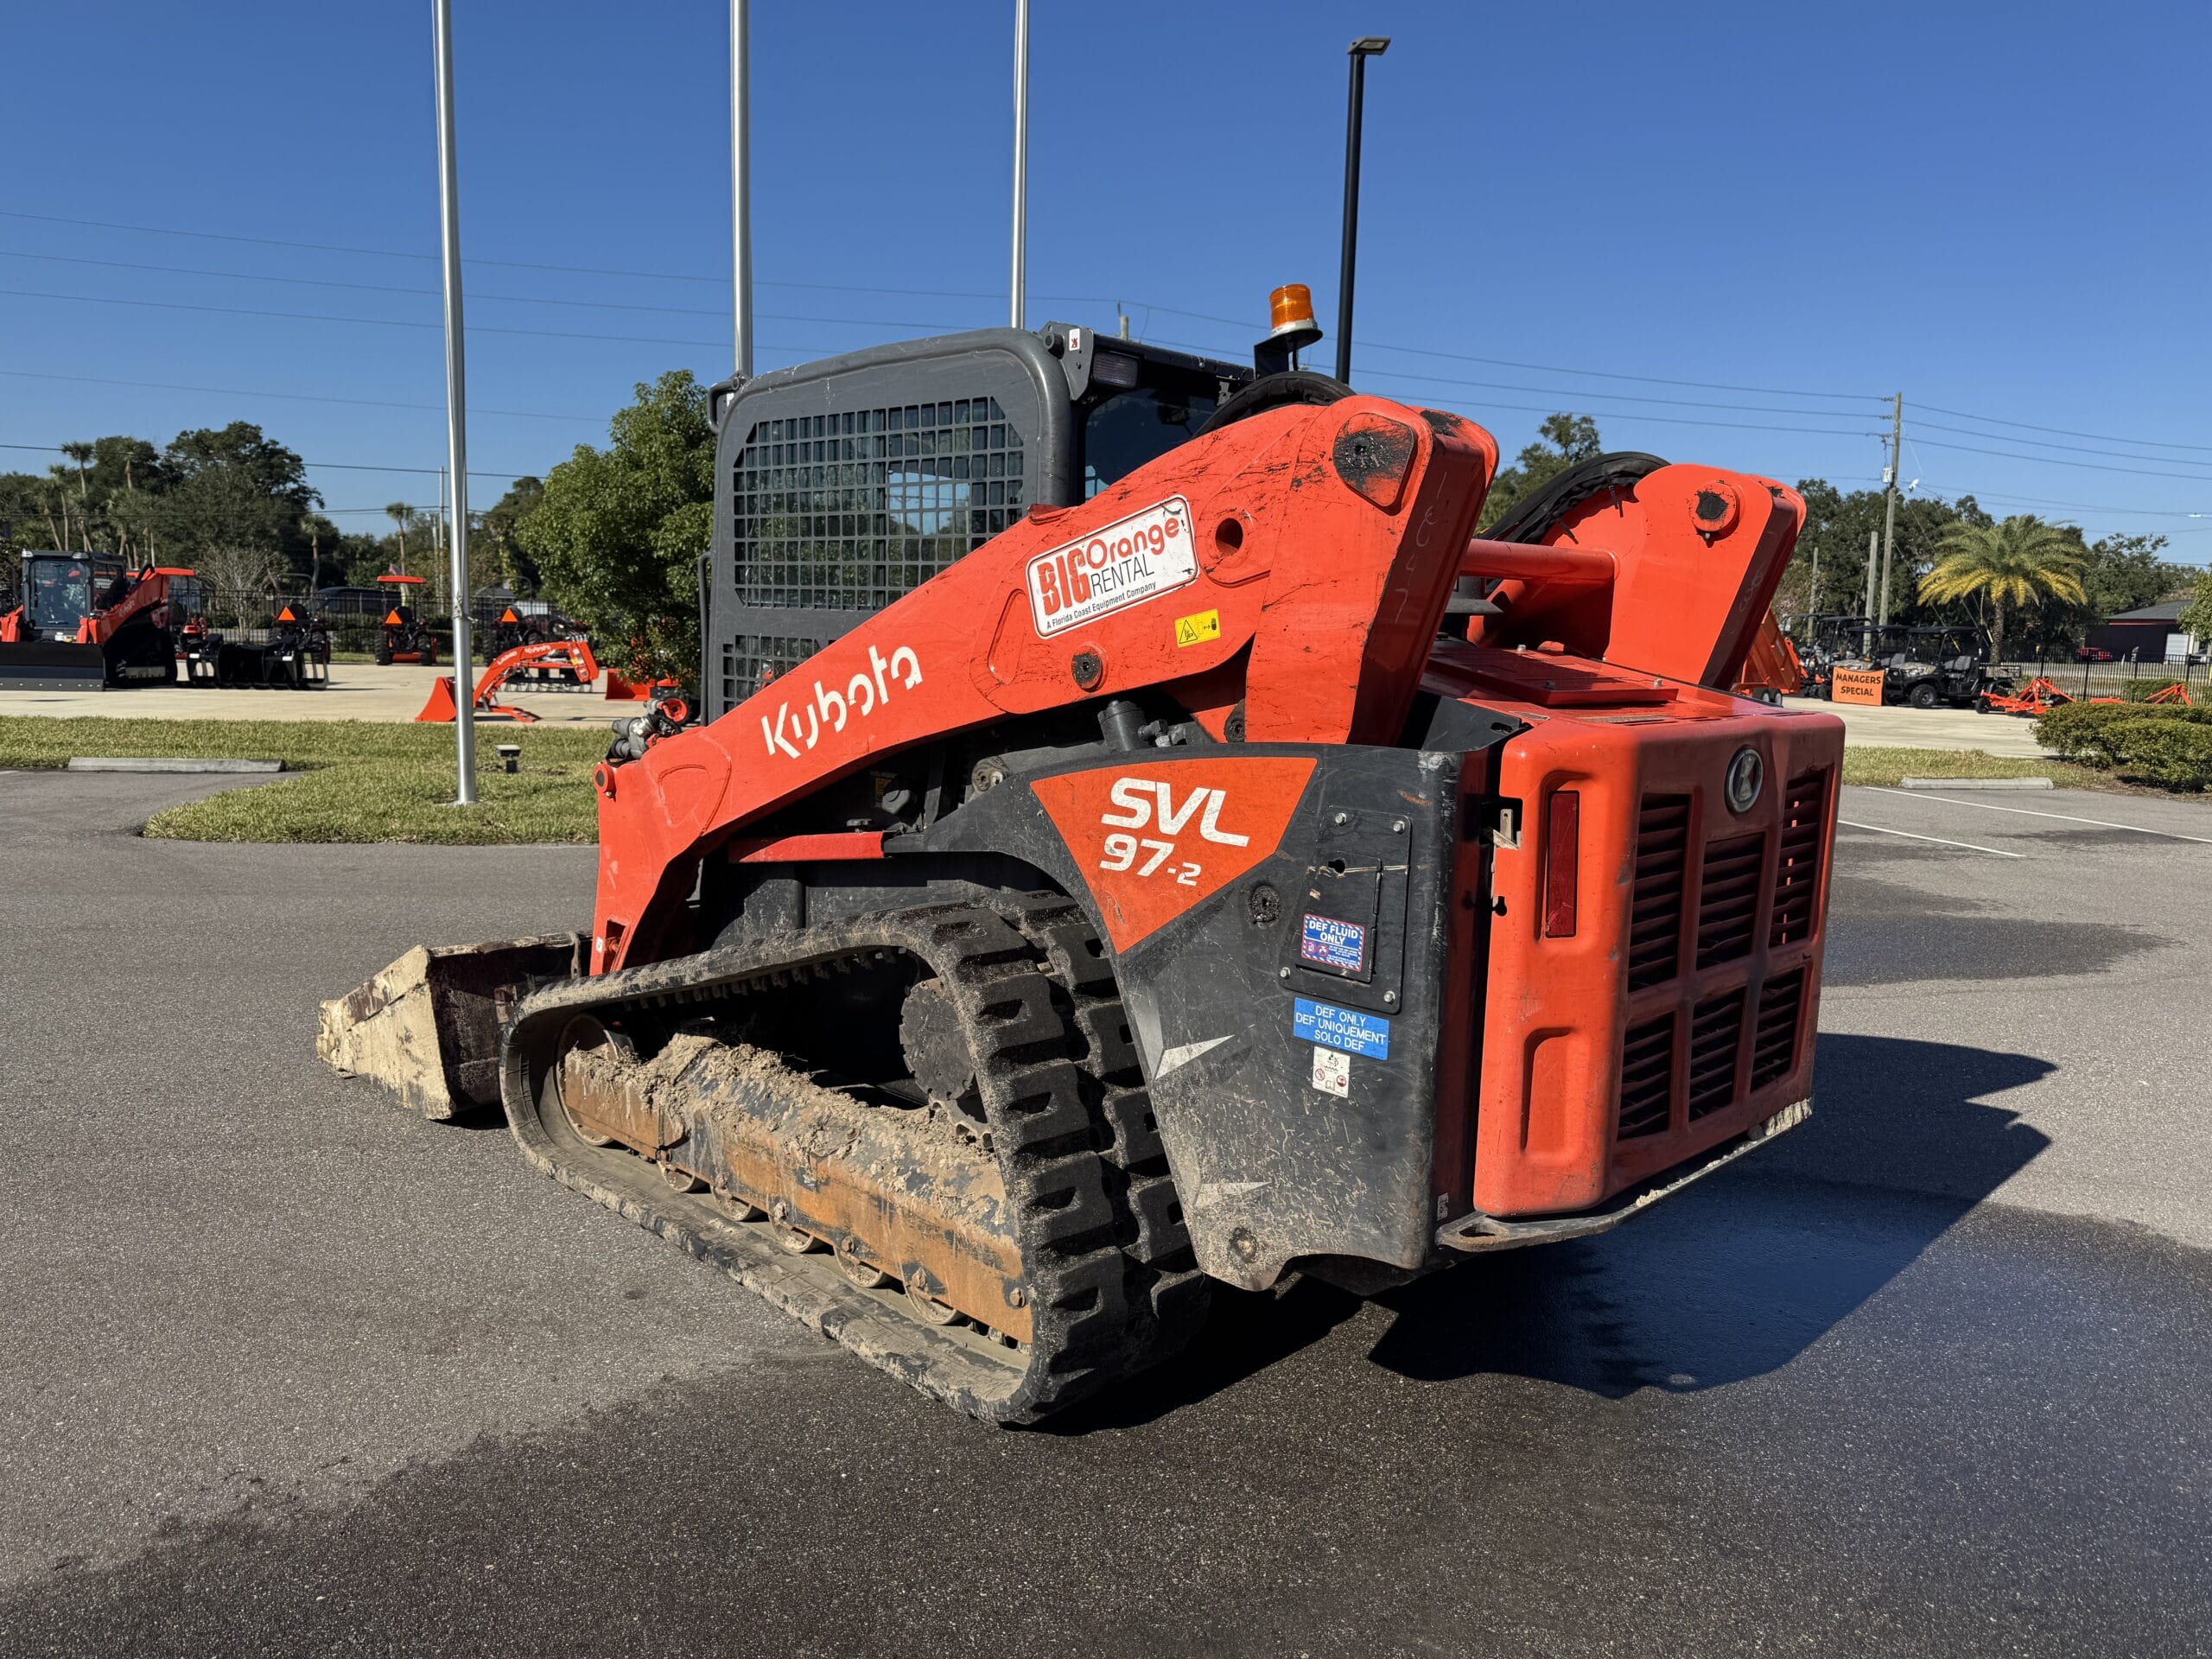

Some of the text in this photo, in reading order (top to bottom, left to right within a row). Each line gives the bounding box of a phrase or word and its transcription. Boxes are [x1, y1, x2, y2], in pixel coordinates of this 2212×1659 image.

[1037, 517, 1179, 615] BIG Orange
[1090, 553, 1155, 597] RENTAL
[1046, 582, 1156, 630] A Florida Coast Equipment Company
[1835, 672, 1882, 684] MANAGERS
[1840, 685, 1874, 696] SPECIAL
[760, 645, 924, 760] Kubota
[1100, 777, 1250, 848] SVL
[1099, 833, 1202, 887] 97-2
[1309, 919, 1358, 939] DEF FLUID
[1319, 931, 1345, 945] ONLY
[1295, 1012, 1387, 1045] DEF UNIQUEMENT
[1315, 1005, 1366, 1027] DEF ONLY
[1314, 1029, 1365, 1052] SOLO DEF
